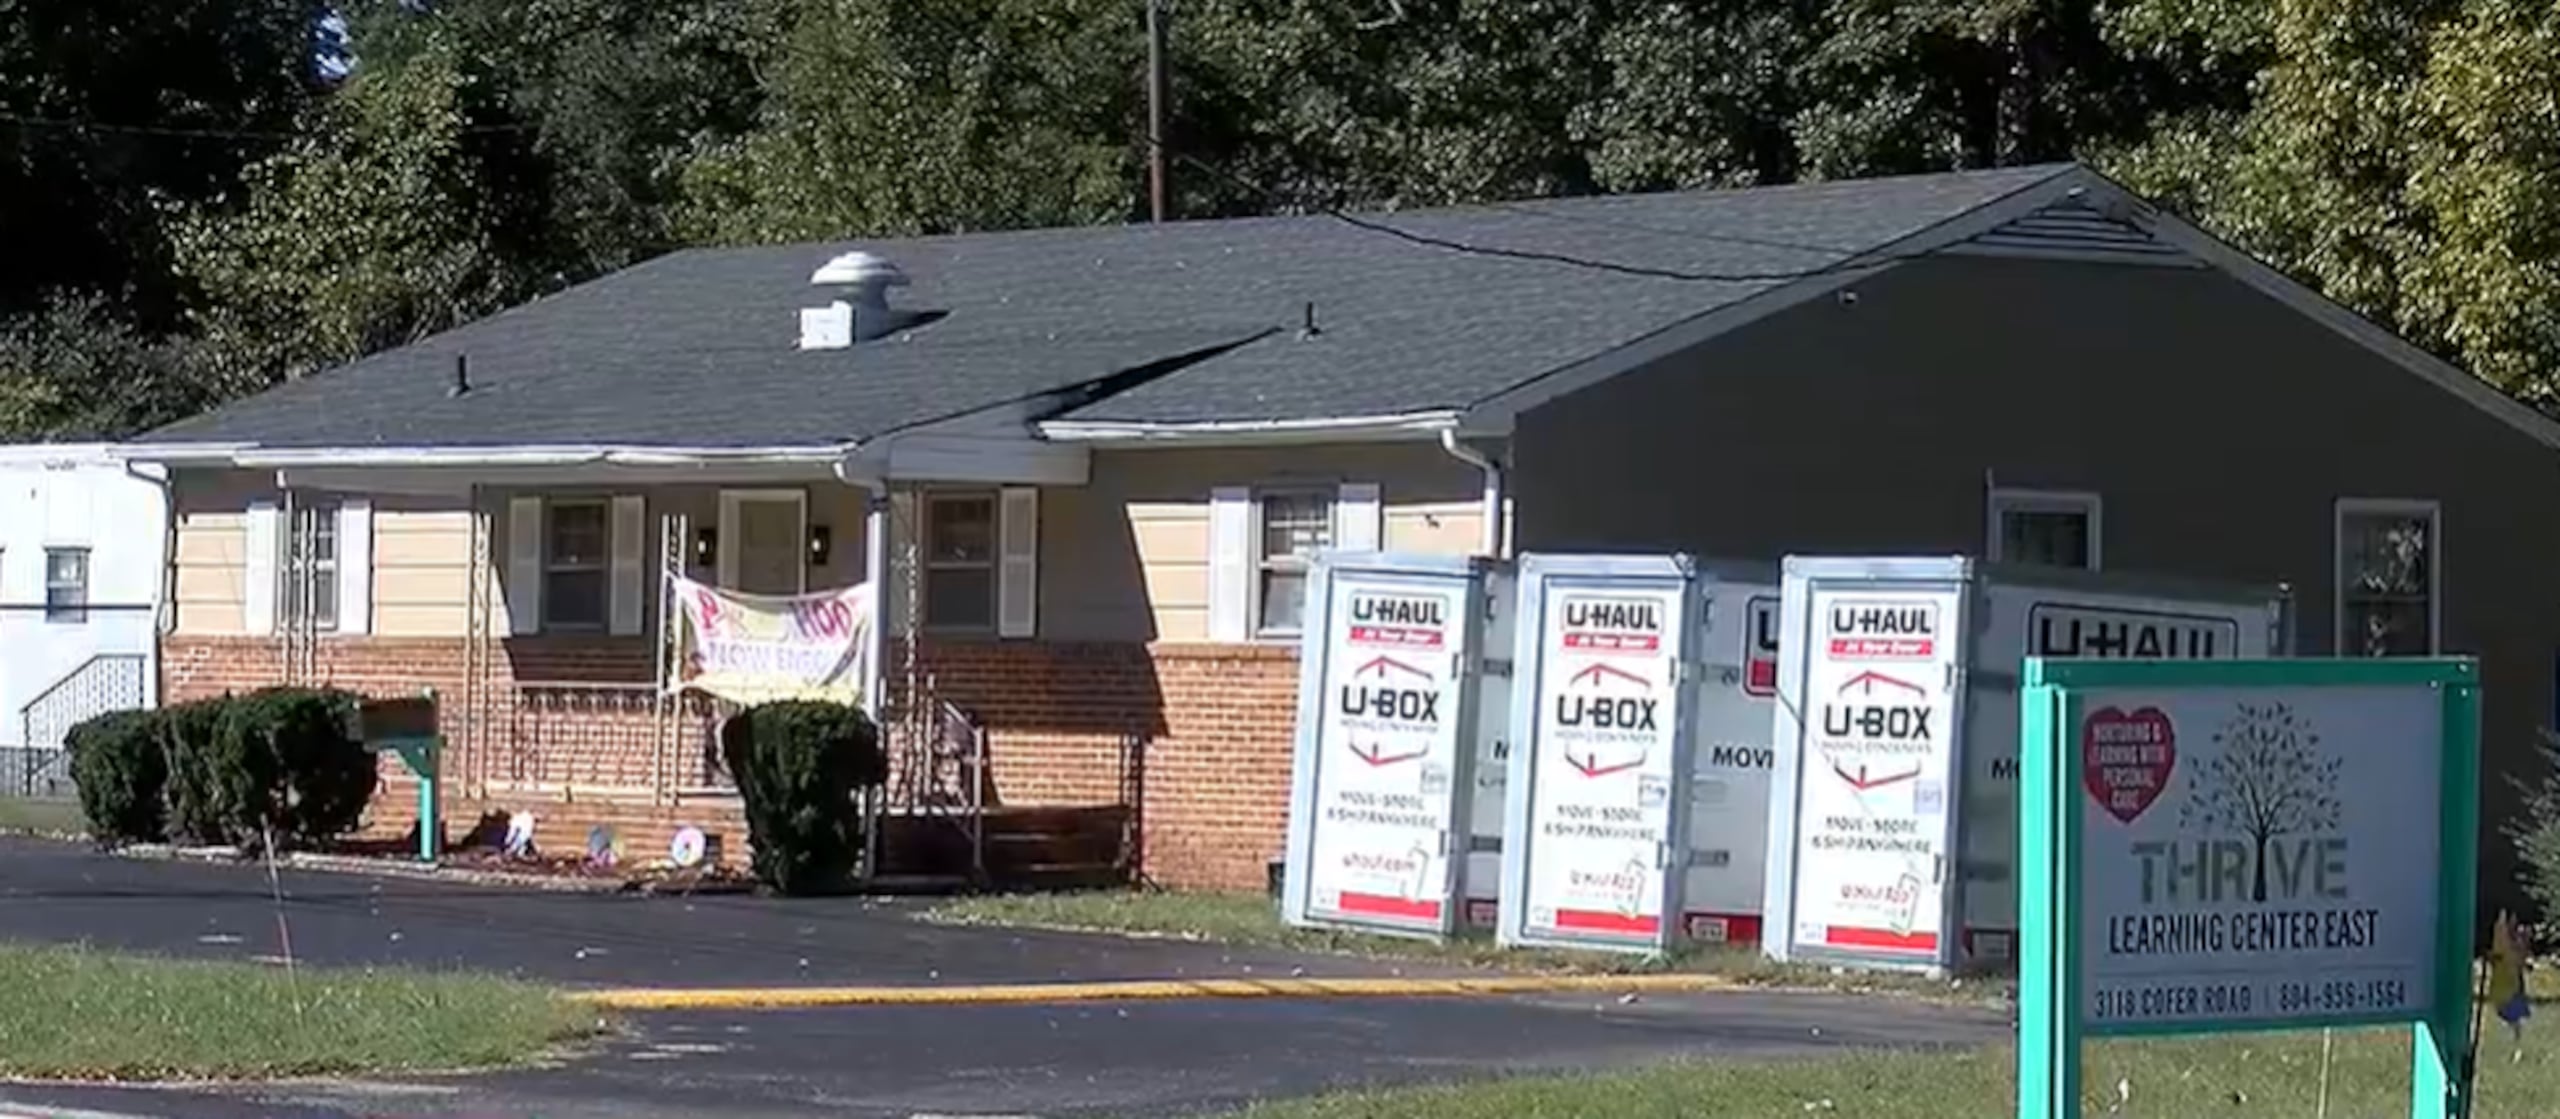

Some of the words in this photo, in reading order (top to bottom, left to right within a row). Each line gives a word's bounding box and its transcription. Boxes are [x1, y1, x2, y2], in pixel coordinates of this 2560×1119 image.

[1353, 598, 1442, 625] U-HAUL
[1567, 603, 1657, 630] U-HAUL
[1834, 608, 1932, 634] U-HAUL
[1342, 685, 1439, 722] U-BOX
[1558, 694, 1657, 731] U-BOX
[1825, 703, 1931, 740] U-BOX
[1712, 745, 1775, 769] MOVI
[2131, 838, 2348, 902] THRIVE
[2109, 913, 2224, 954] LEARNING
[2230, 910, 2319, 950] CENTER
[2323, 909, 2379, 948] EAST
[2141, 986, 2198, 1016] COFER
[2204, 984, 2251, 1014] ROAD
